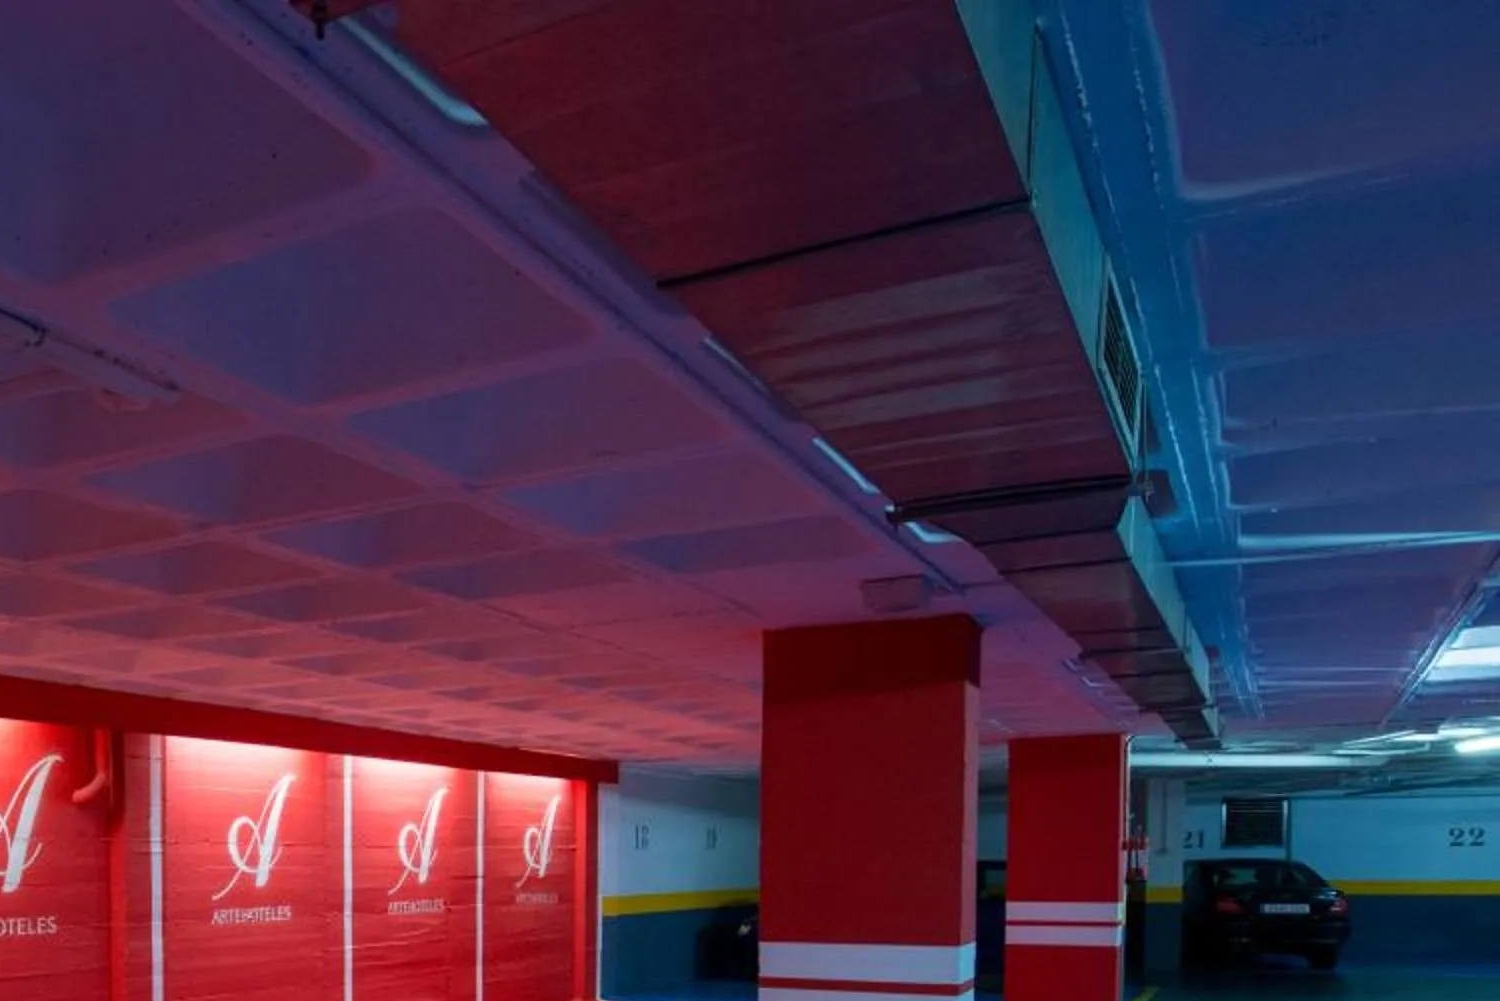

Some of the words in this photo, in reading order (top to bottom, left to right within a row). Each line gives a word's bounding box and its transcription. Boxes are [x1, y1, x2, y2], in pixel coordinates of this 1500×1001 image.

[211, 773, 296, 901] A
[388, 786, 449, 896] A
[1448, 826, 1486, 847] 22
[210, 905, 292, 926] ARTEHOTELES
